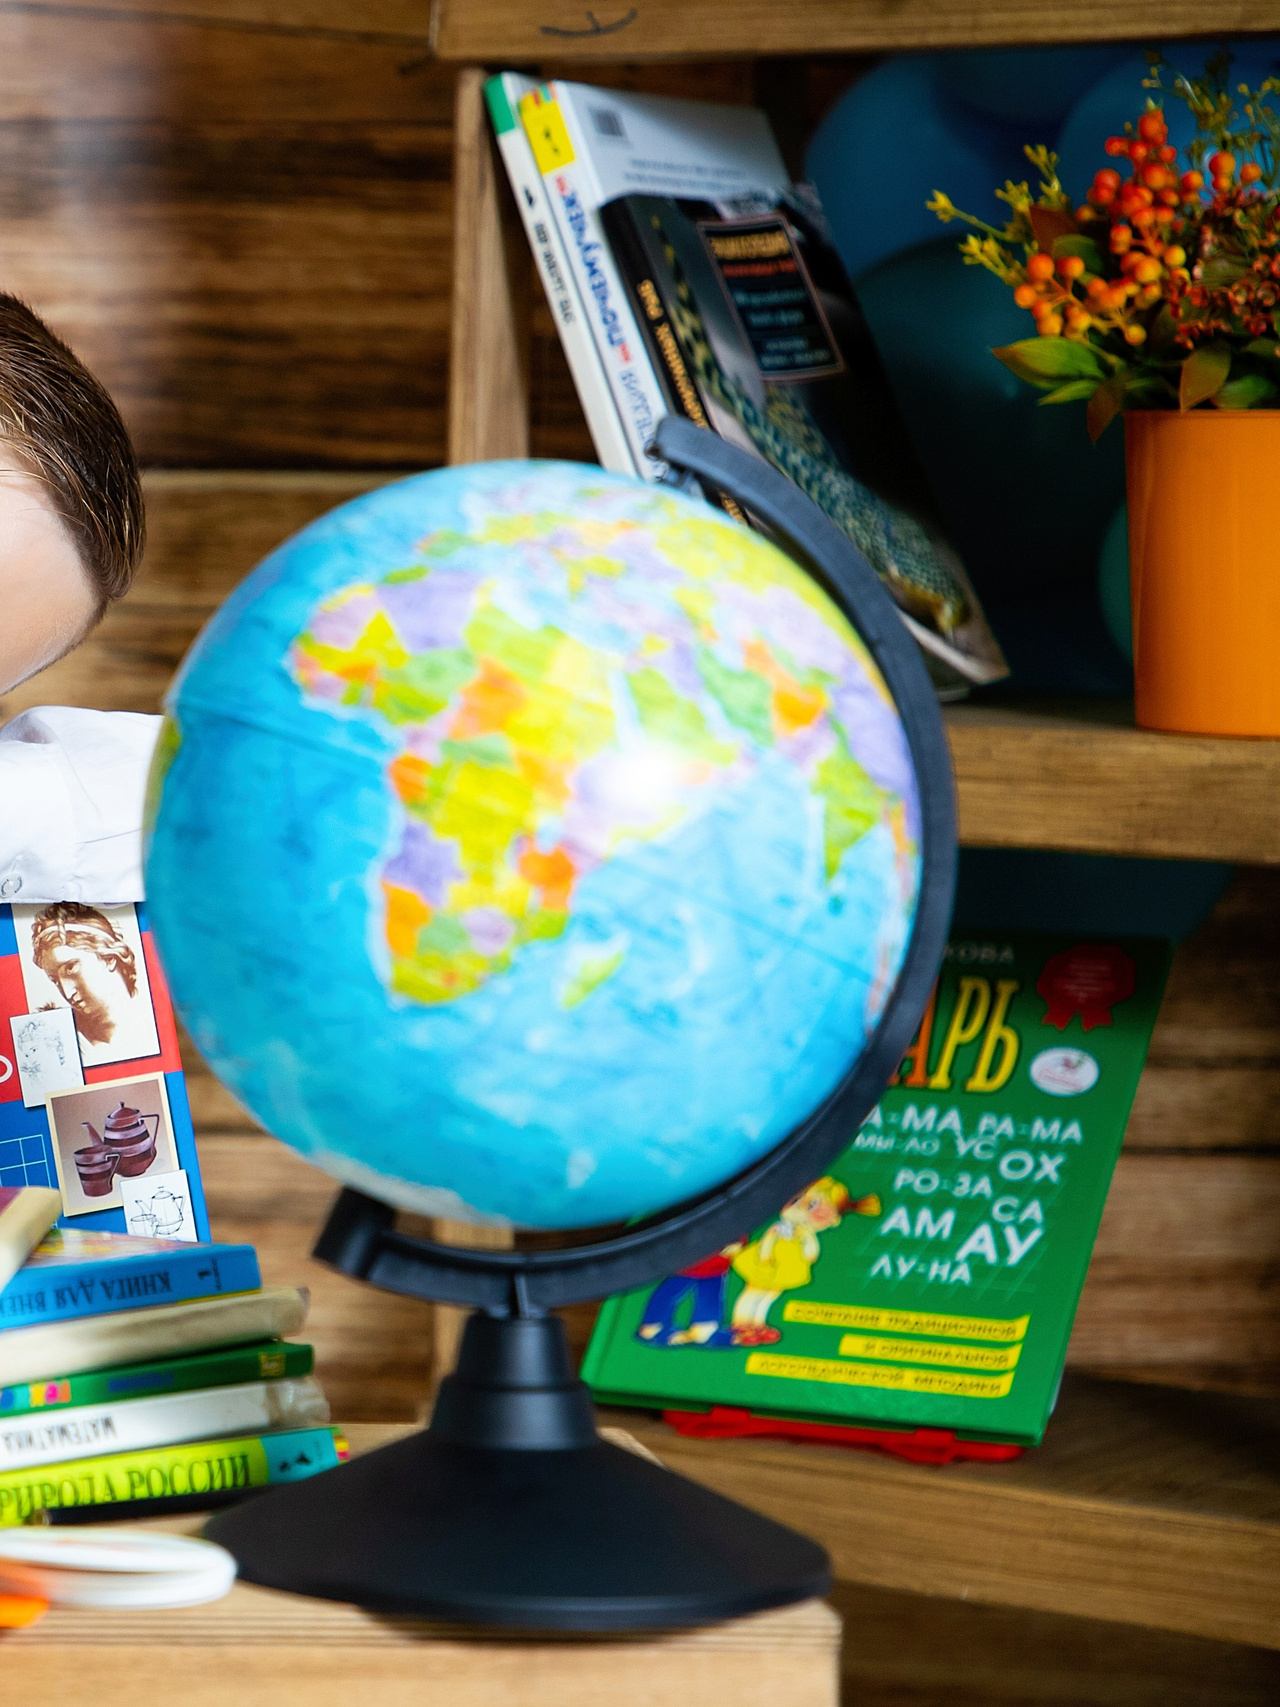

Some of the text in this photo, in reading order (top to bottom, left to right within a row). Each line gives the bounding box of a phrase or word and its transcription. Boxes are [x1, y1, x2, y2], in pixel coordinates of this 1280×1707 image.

[978, 1113, 1083, 1144] РА-МА
[999, 1150, 1066, 1183] ОХ
[893, 1168, 993, 1198] РО-ЗА
[880, 1196, 1043, 1240] АМ СА
[955, 1222, 1044, 1266] АУ
[870, 1254, 971, 1285] ЛУ-НА
[54, 1279, 97, 1308] ДЛЯ
[102, 1271, 172, 1301] КНИГА
[127, 1453, 251, 1500] РОССИИ
